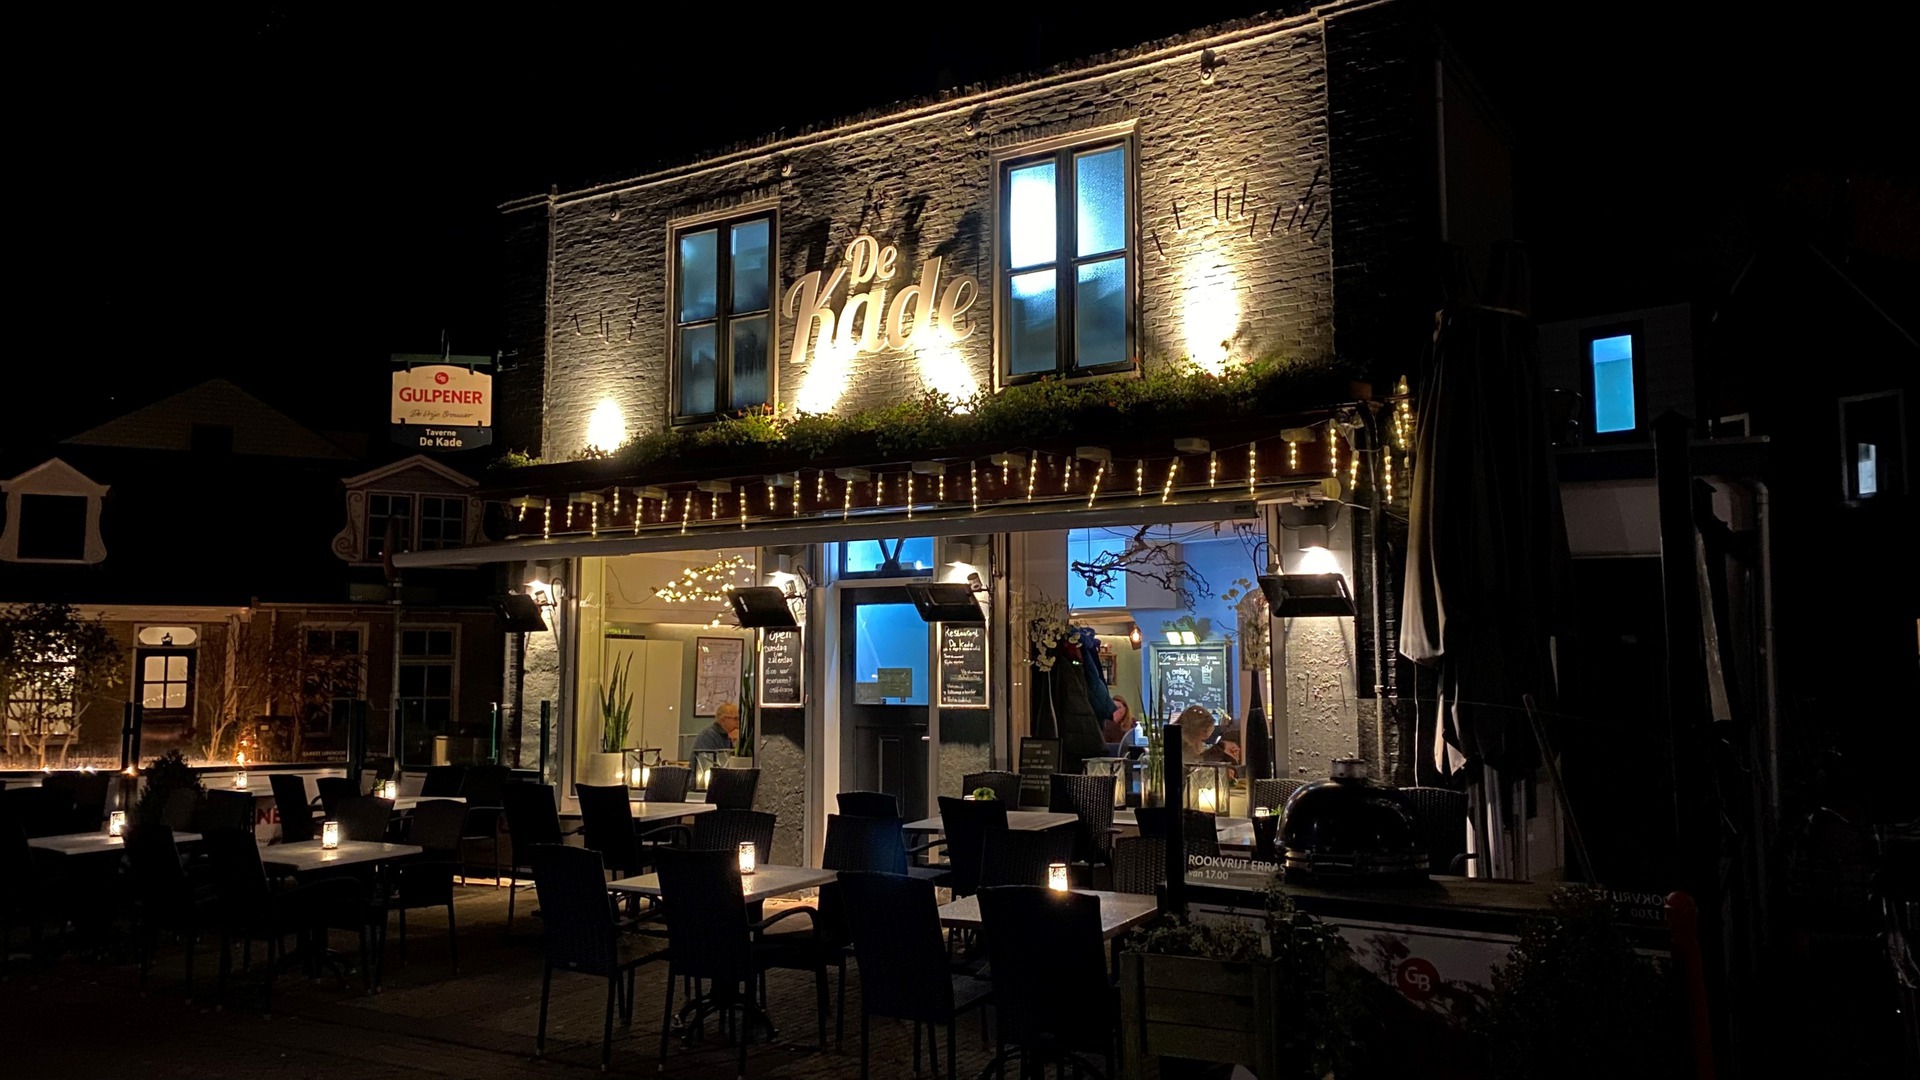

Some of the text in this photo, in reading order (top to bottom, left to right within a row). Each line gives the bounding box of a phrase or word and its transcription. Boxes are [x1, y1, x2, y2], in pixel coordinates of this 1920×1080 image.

[845, 235, 898, 284] De
[782, 255, 979, 364] Kade
[399, 387, 482, 404] GULPENER
[425, 428, 457, 437] Taverne
[419, 437, 463, 447] De Kade
[769, 631, 792, 643] Open
[1188, 869, 1229, 880] van 17.00
[1404, 966, 1431, 992] GB
